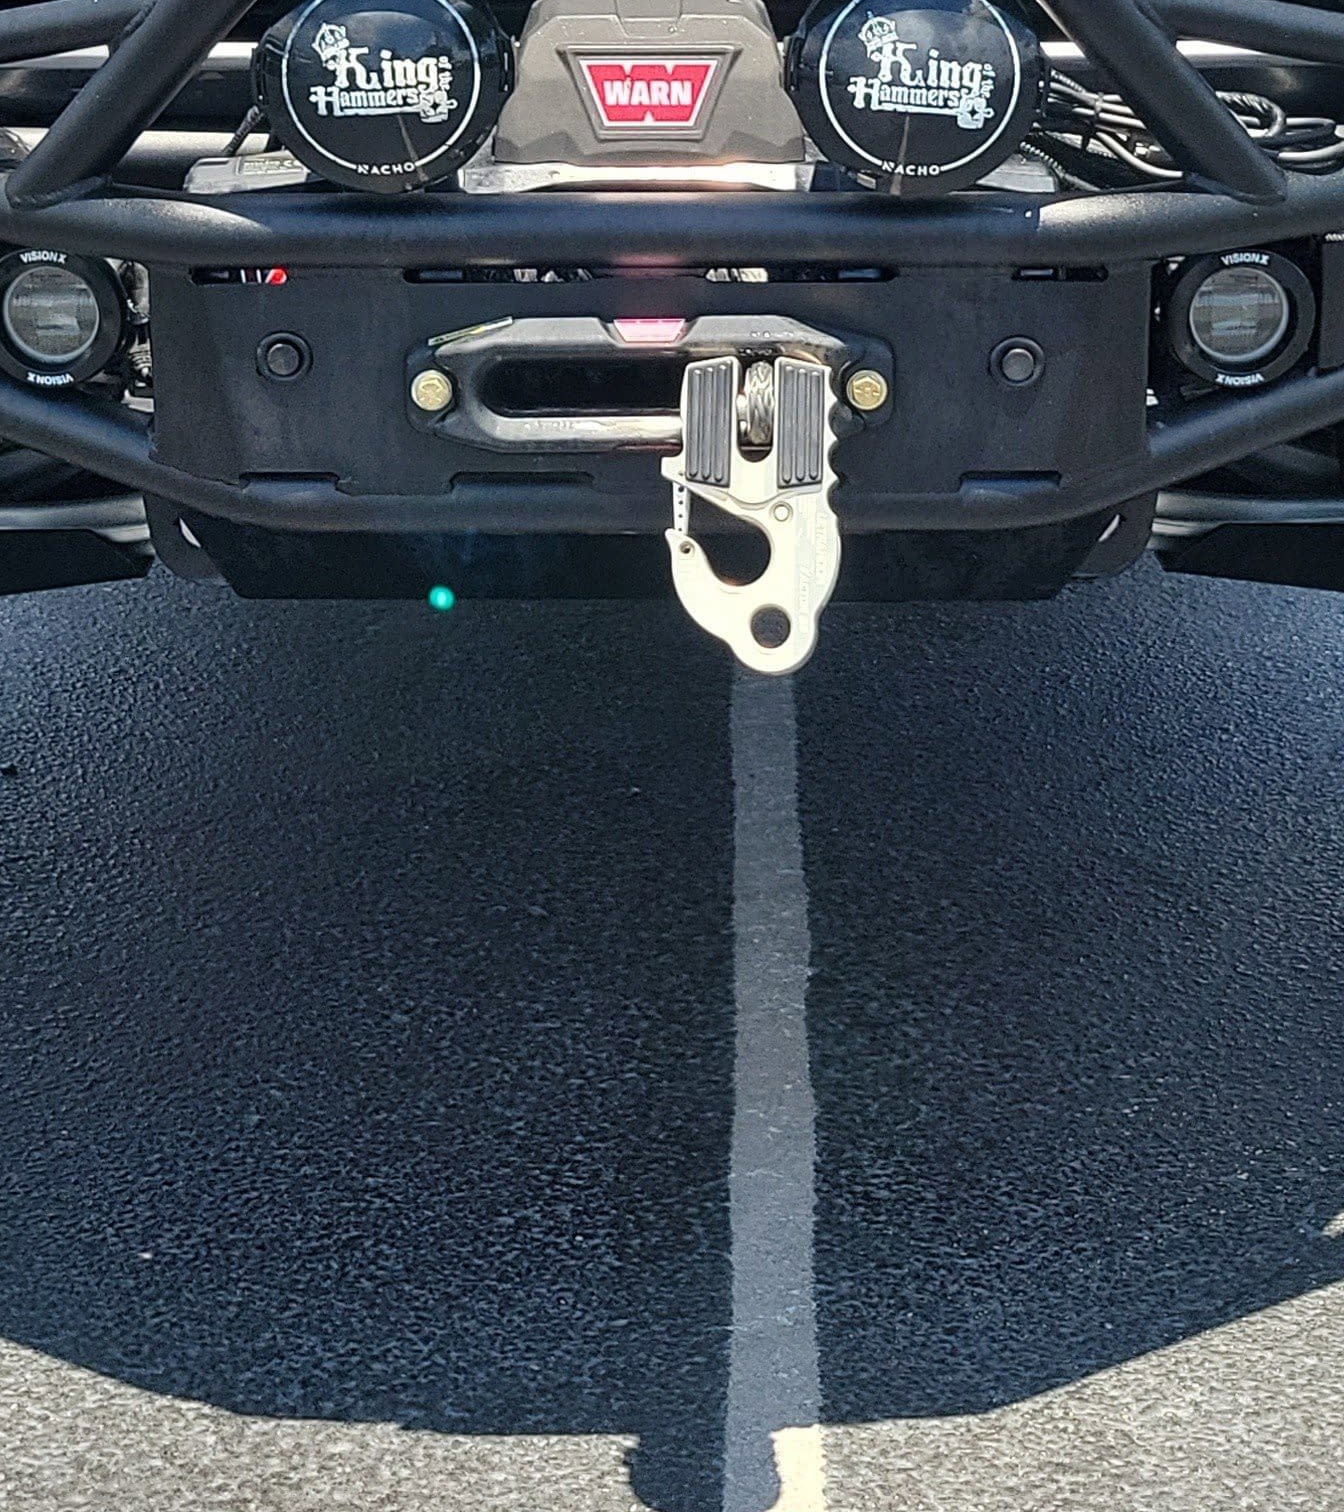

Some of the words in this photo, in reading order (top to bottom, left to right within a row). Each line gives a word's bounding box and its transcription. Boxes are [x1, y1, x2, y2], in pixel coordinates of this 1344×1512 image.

[323, 46, 439, 94] King
[870, 41, 984, 96] King
[309, 86, 421, 116] Hammers
[603, 80, 692, 106] WARN
[847, 76, 960, 110] Hammers
[357, 162, 415, 176] NACHO
[882, 160, 940, 176] NACHO
